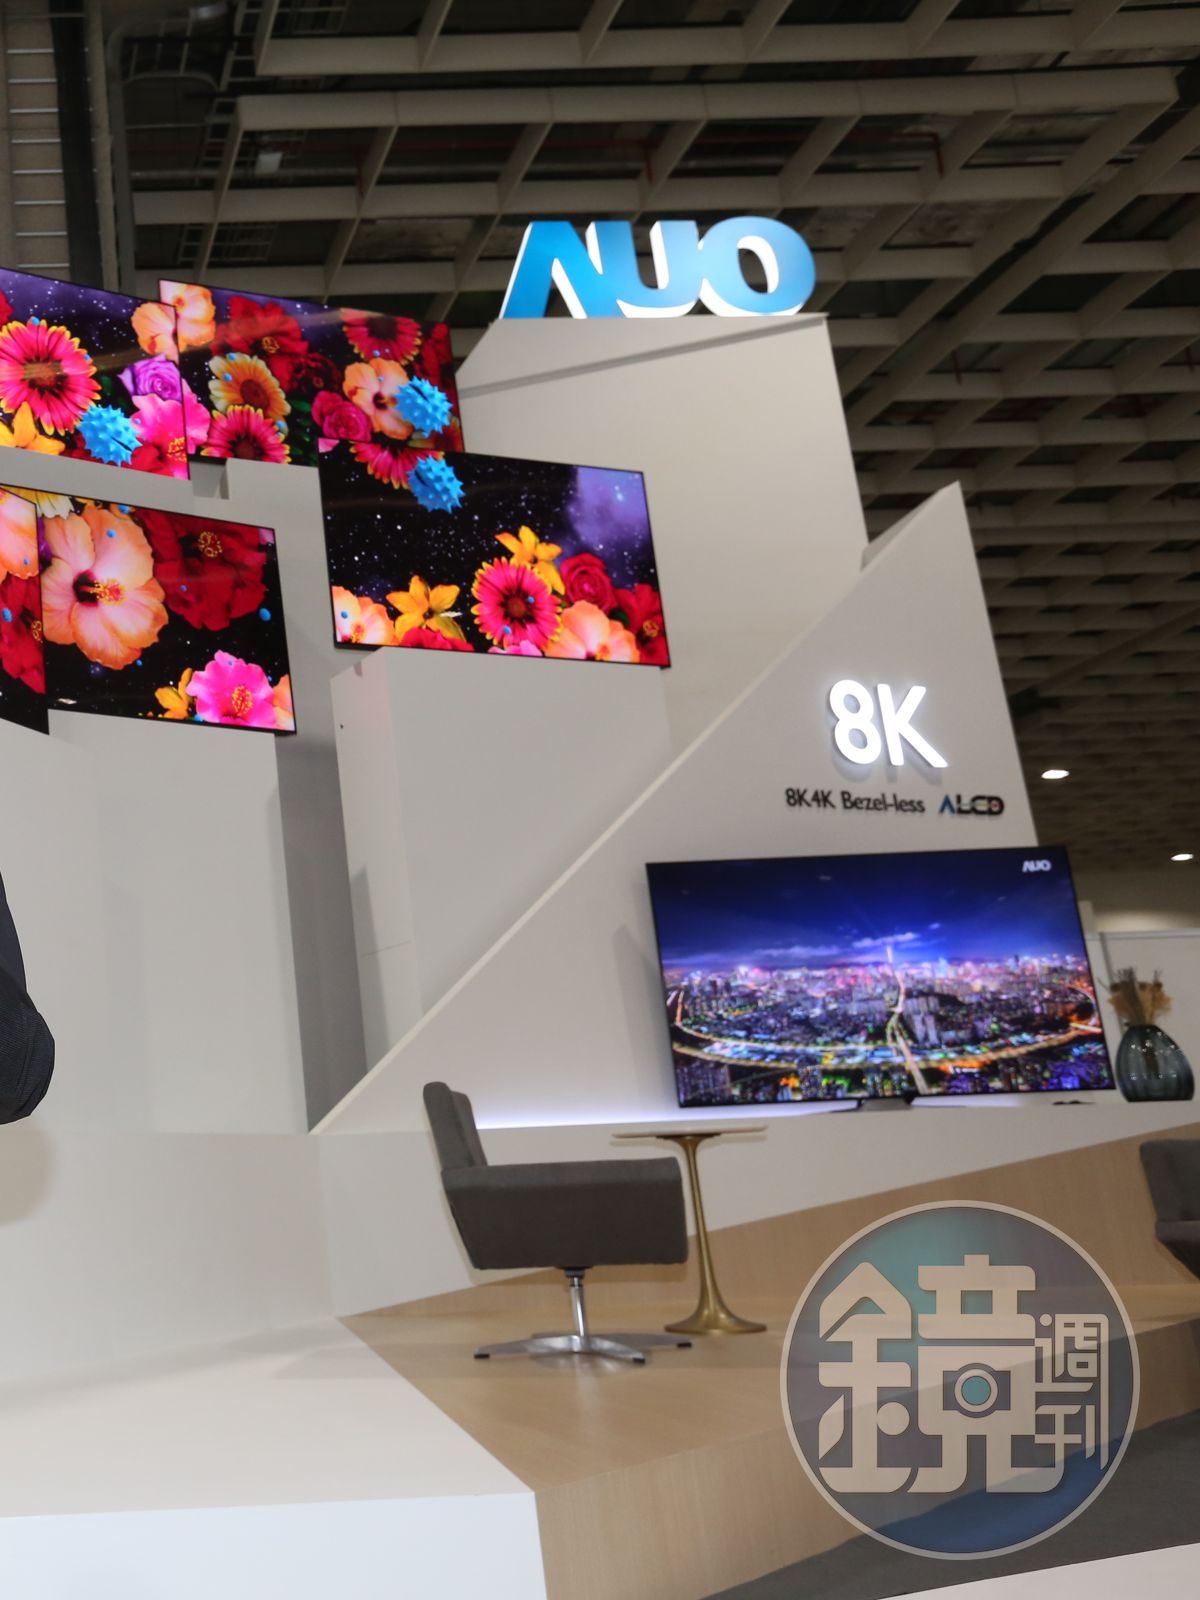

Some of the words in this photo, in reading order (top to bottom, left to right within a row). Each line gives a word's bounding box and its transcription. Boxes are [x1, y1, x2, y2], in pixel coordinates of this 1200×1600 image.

[499, 216, 816, 319] AUO
[829, 679, 948, 768] 8K
[785, 788, 835, 809] 8K4K
[841, 791, 925, 813] Bezel-less
[1022, 859, 1052, 873] AUO
